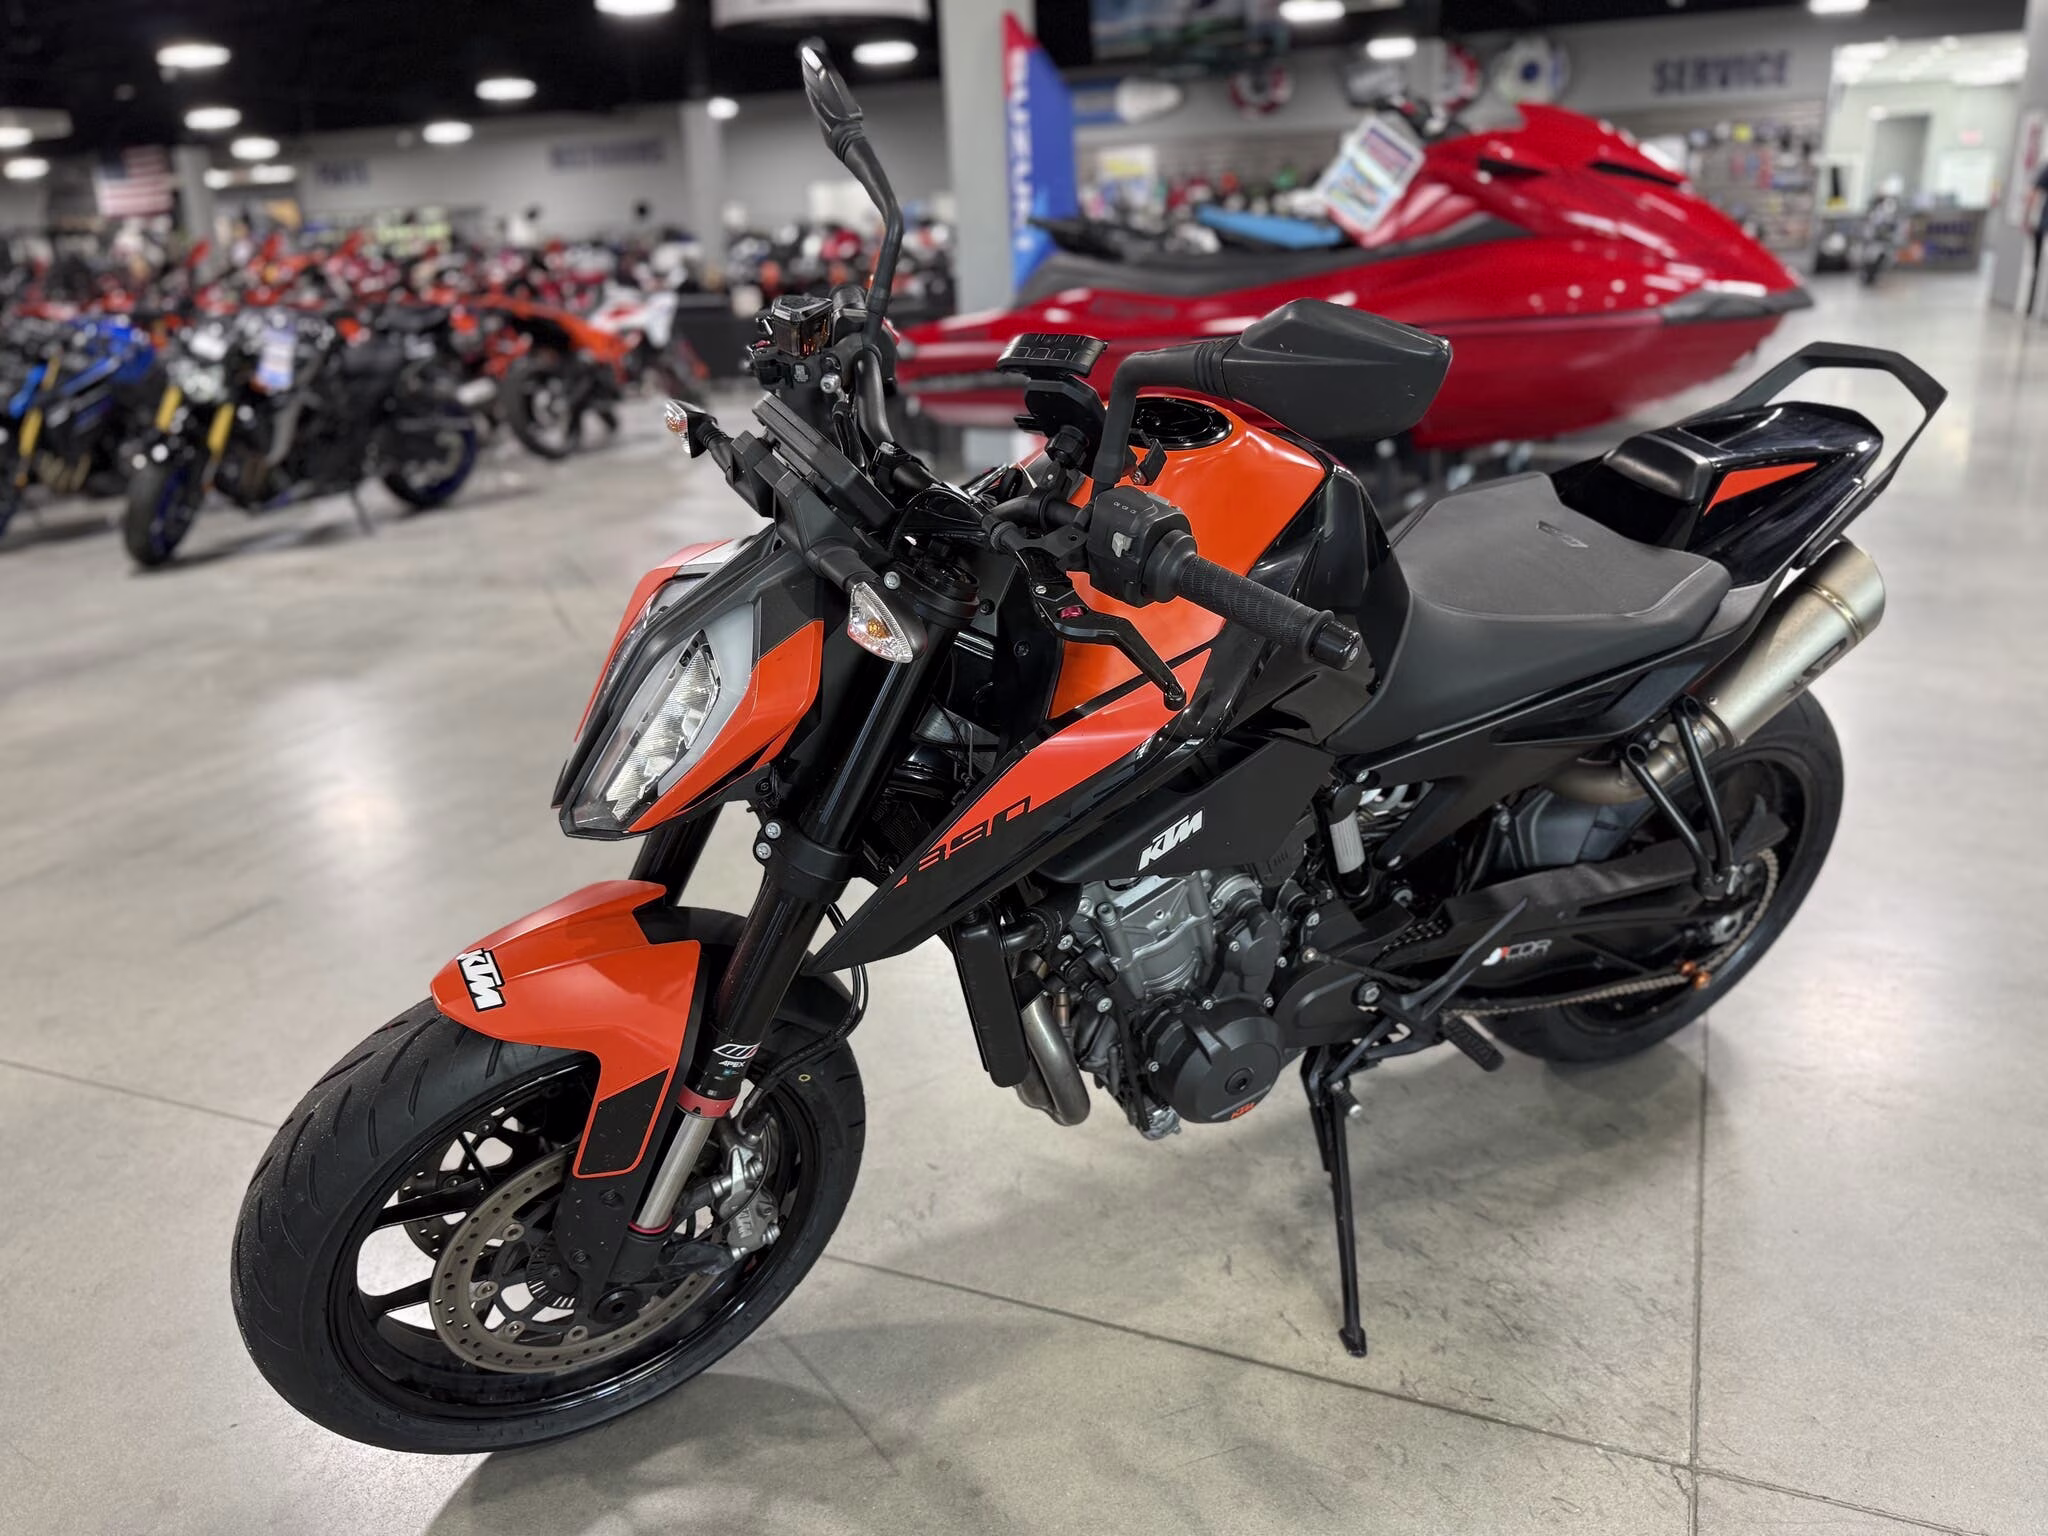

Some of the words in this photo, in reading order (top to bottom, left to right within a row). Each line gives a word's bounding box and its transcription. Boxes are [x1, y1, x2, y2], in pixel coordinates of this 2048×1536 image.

[1652, 49, 1793, 98] SERVICE
[1138, 809, 1203, 871] KTM
[457, 949, 505, 1010] KTM
